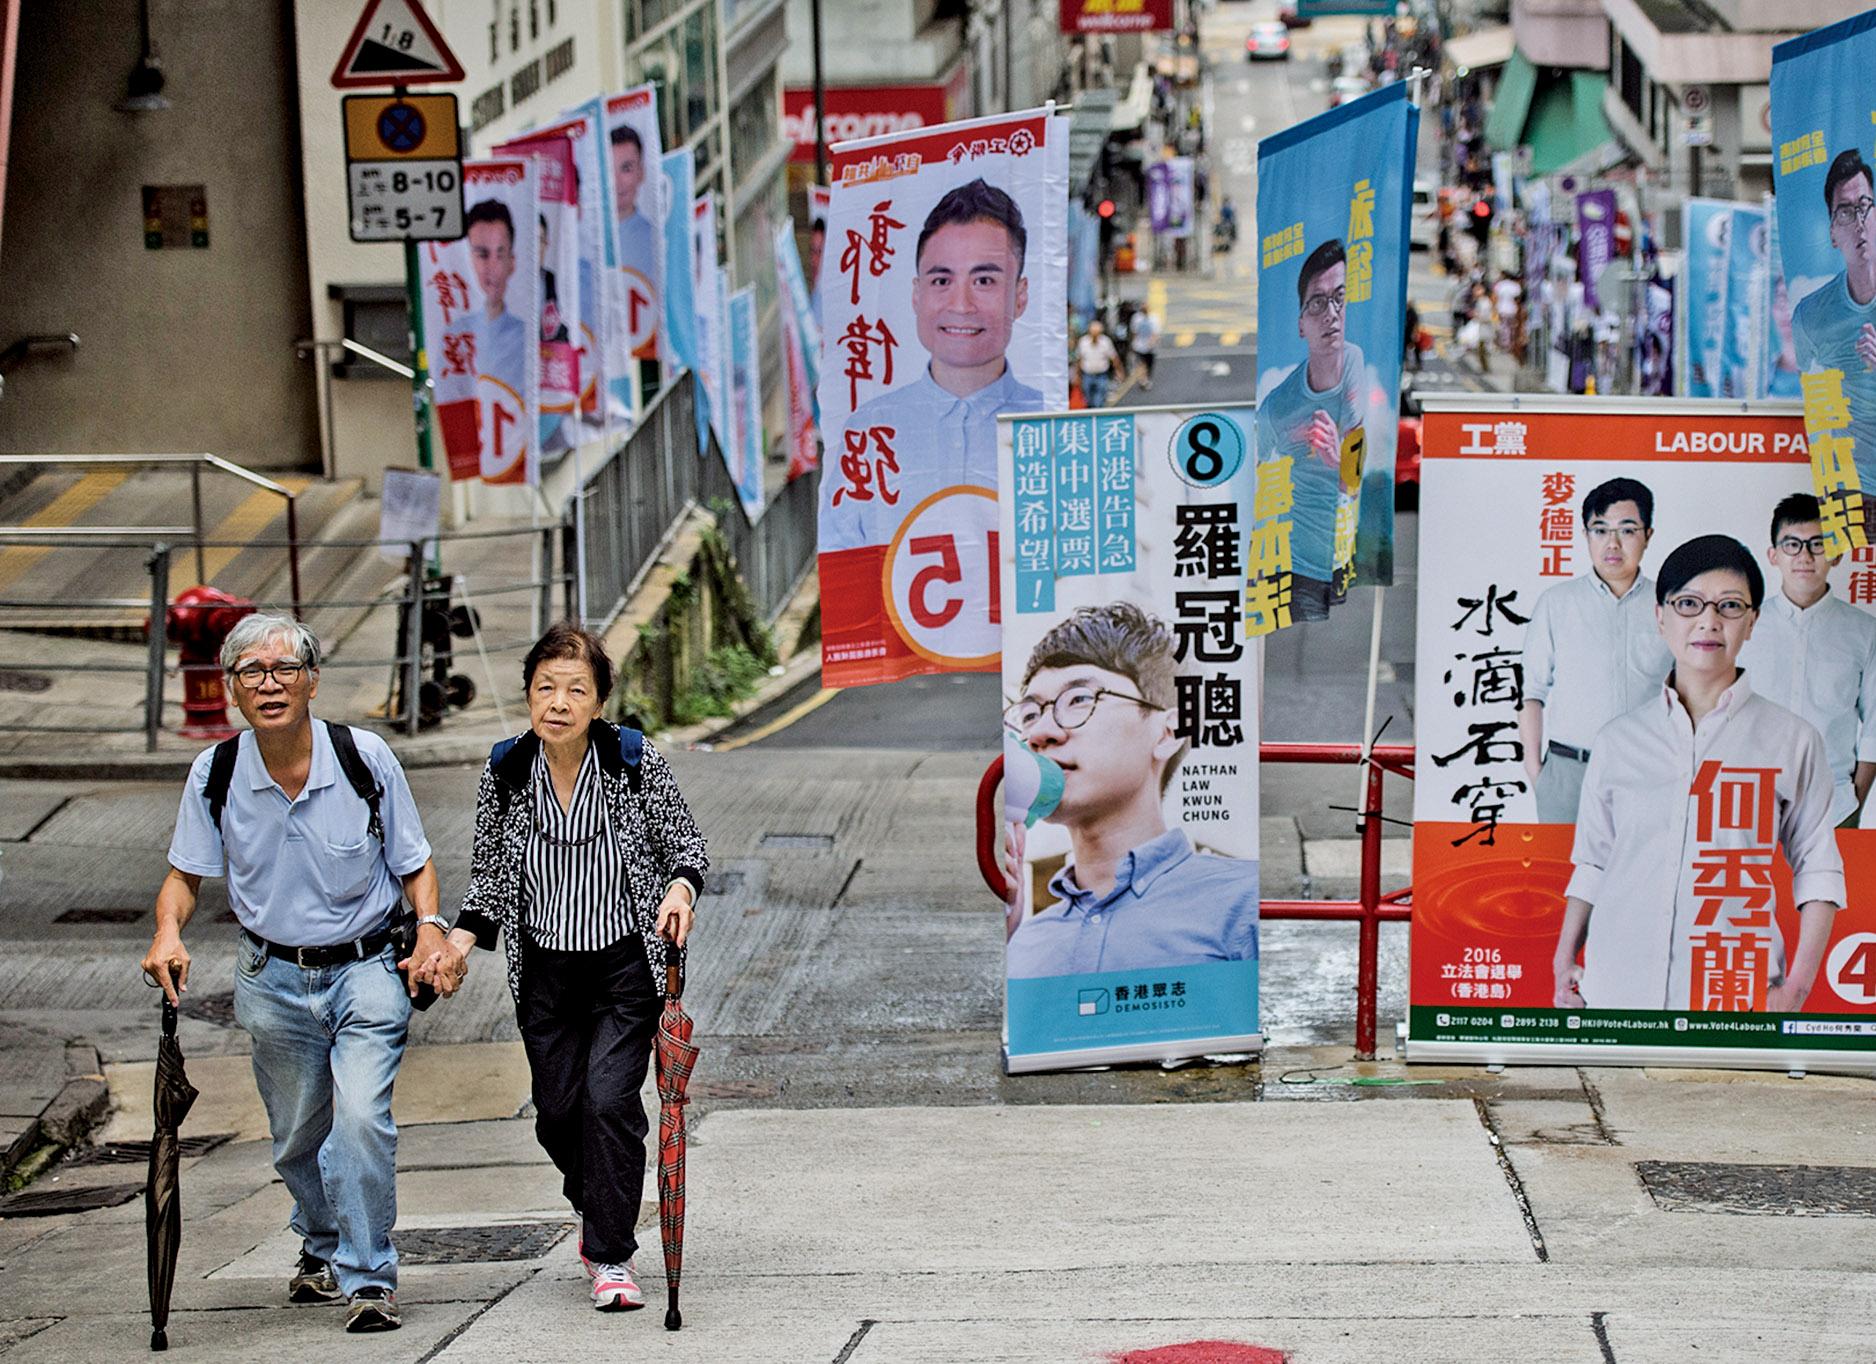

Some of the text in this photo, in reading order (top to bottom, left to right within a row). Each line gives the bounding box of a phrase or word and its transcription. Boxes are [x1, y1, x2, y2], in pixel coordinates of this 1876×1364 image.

[393, 170, 455, 193] 8-10
[394, 207, 446, 229] 5-7
[1459, 422, 1528, 455] 工黨
[1655, 432, 1808, 454] LABOUR PA
[1186, 422, 1223, 480] 8
[1058, 421, 1091, 570] 集中選票
[1101, 418, 1134, 568] 香港告急
[1538, 472, 1576, 577] 麥德正
[1173, 503, 1244, 748] 羅冠聰
[1431, 584, 1532, 847] 水滴石穿
[1182, 764, 1238, 777] NATHAN
[1182, 780, 1210, 791] LAW
[1182, 795, 1222, 807] KWUN
[1182, 810, 1230, 822] CHUNG
[1689, 760, 1783, 1012] 何秀蘭
[1463, 947, 1502, 963] 2016
[1450, 1016, 1493, 1026] 2117 0204
[1515, 1017, 1559, 1027] 2895 2138
[1689, 1020, 1777, 1032] www.Vote4Labour.hk
